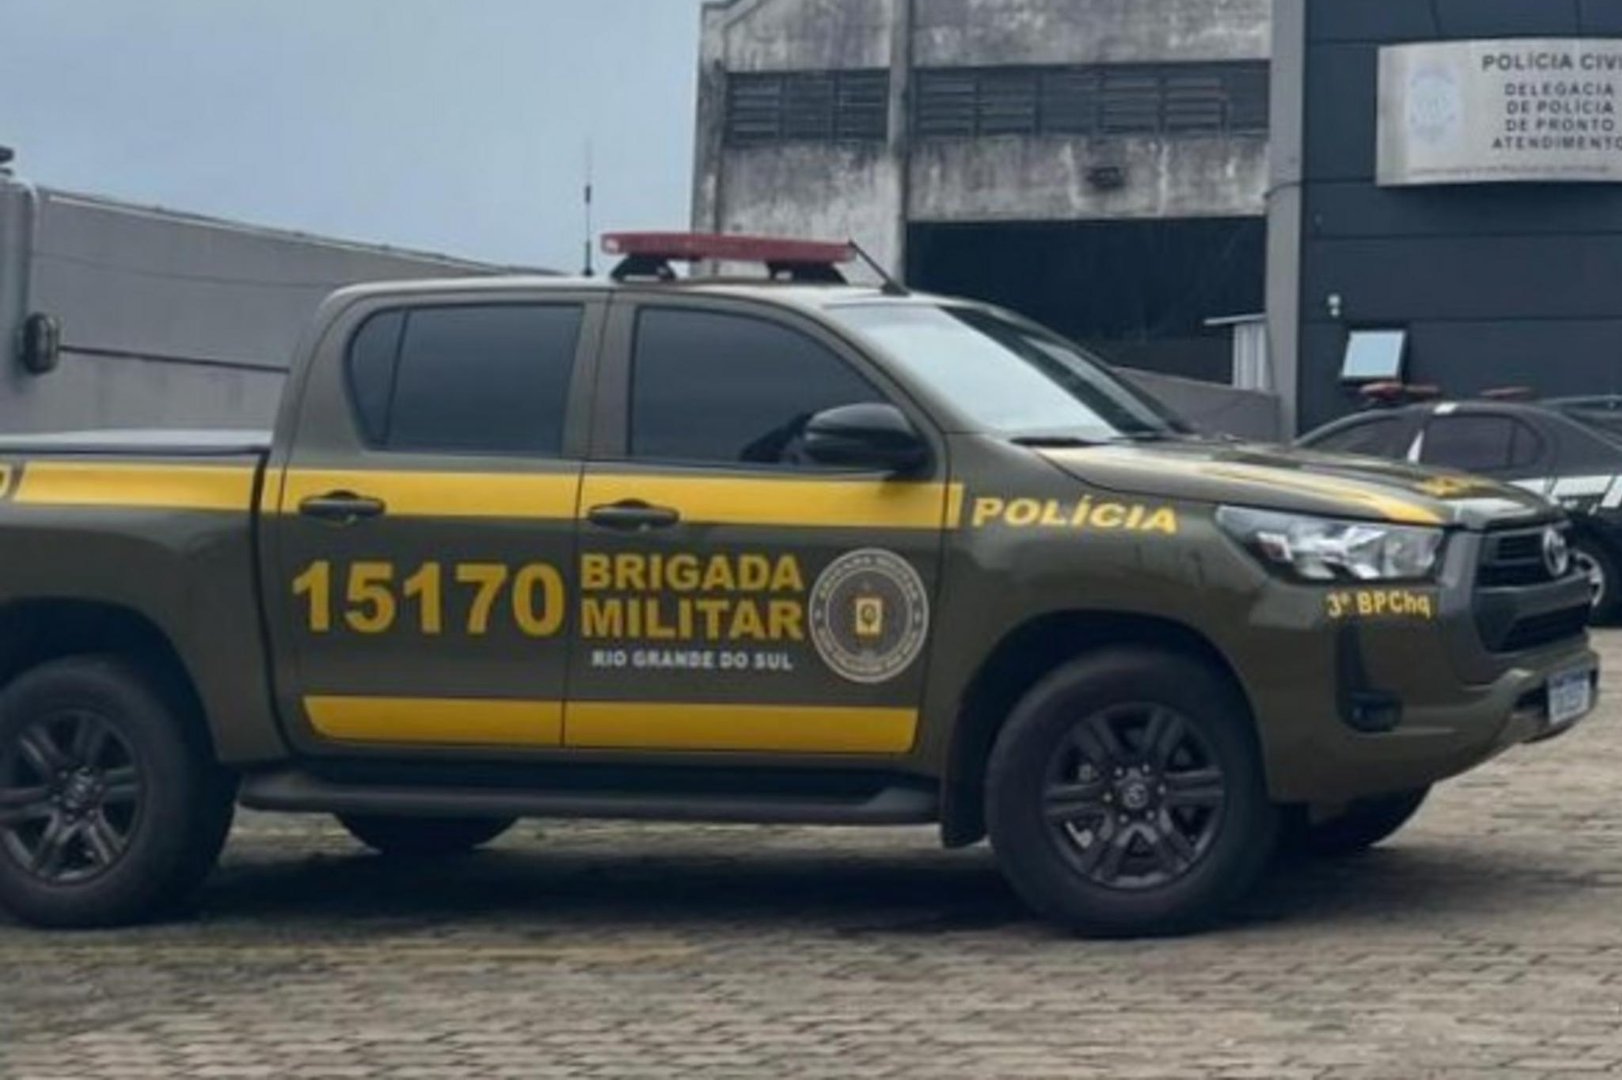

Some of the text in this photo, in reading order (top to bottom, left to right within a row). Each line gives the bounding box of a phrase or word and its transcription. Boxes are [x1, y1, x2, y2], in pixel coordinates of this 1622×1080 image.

[1482, 52, 1573, 71] POLÍCIA
[1505, 83, 1614, 98] DELEGACIA
[1507, 100, 1530, 115] DE
[1506, 118, 1615, 133] DE PRONTO
[972, 493, 1178, 534] POLÍCIA
[580, 553, 805, 591] BRIGADA
[292, 559, 566, 637] 15170
[1357, 591, 1431, 619] BPChq
[581, 599, 805, 640] MILITAR
[592, 651, 794, 670] RIO GRANDE DO SUL
